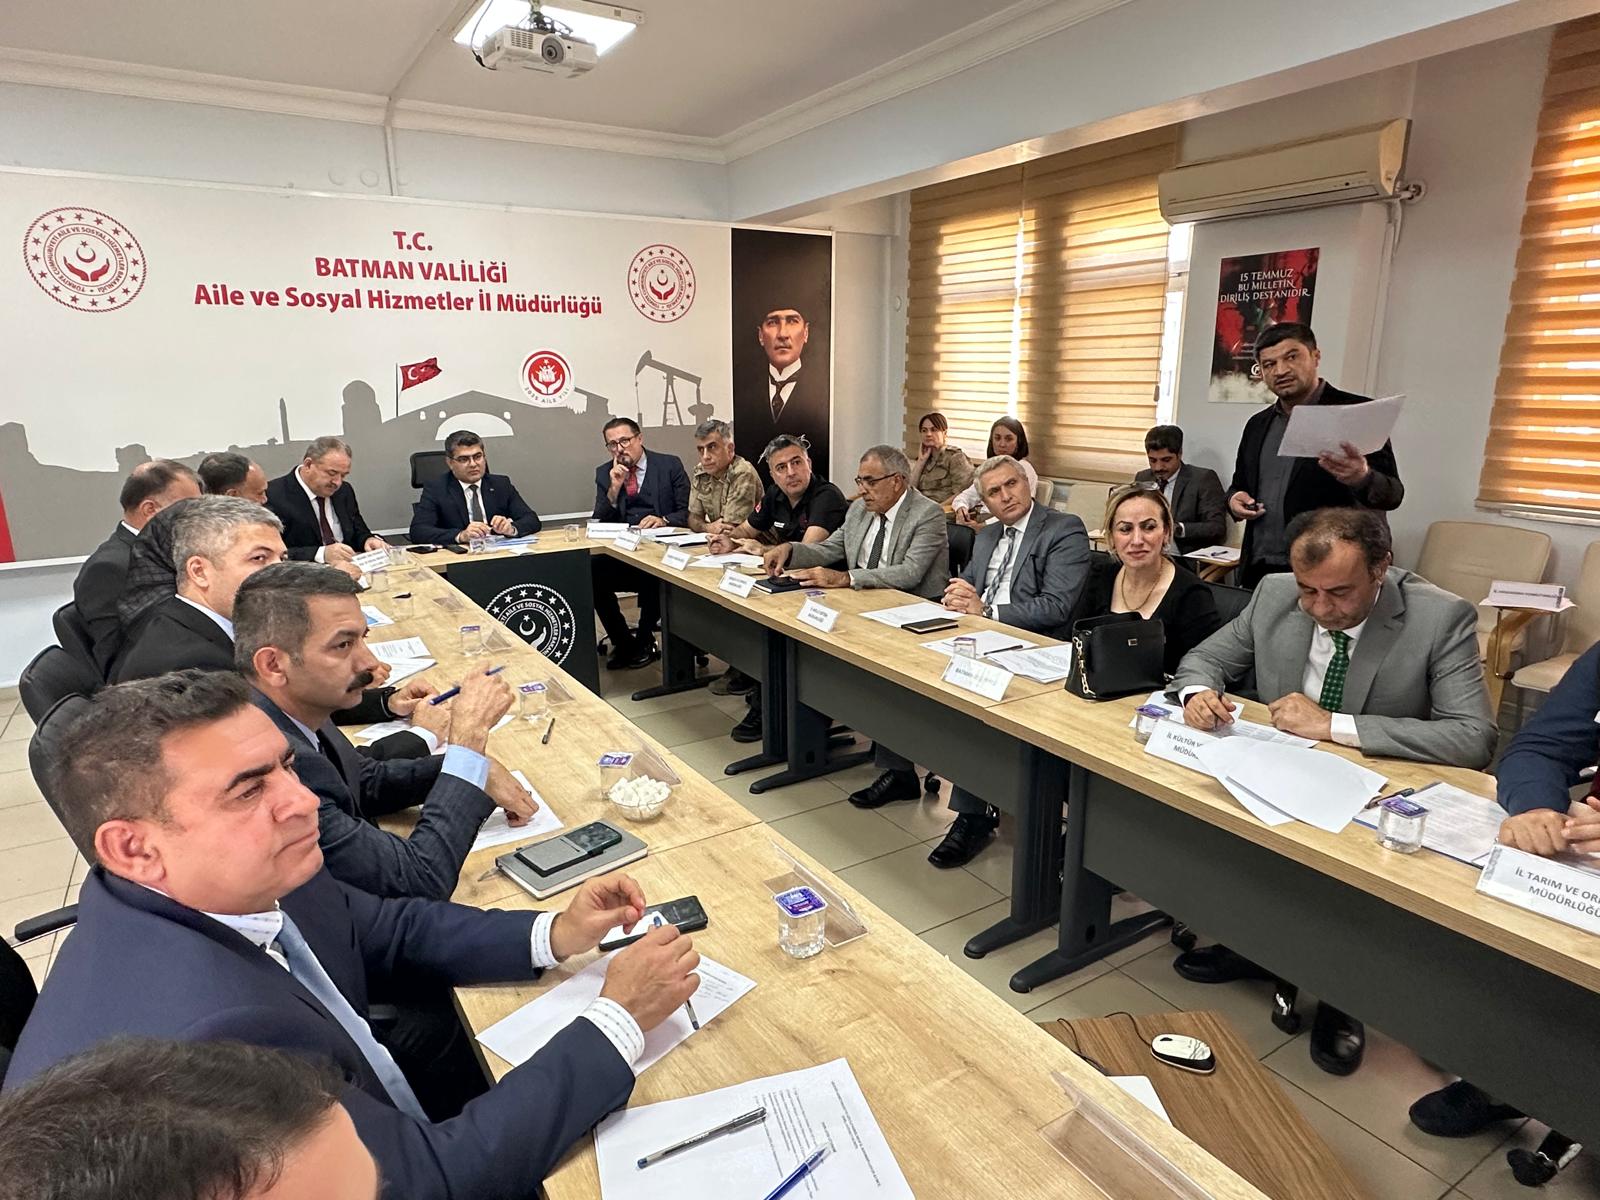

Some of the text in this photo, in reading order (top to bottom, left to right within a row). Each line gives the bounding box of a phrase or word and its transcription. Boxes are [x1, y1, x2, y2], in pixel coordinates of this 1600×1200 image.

[57, 228, 70, 237] AİLE
[81, 227, 106, 240] SOSYAL
[393, 231, 433, 251] T.C.
[315, 257, 508, 283] BATMAN VALİLİĞİ
[1240, 268, 1294, 282] 15 TEMMUZ
[1238, 278, 1297, 292] BU MİLLETİN
[194, 283, 602, 318] Aile ve Sosyal Hizmetler İl Müdürlüğü
[1220, 288, 1312, 304] DİRİLİŞ DESTANIDIR
[506, 606, 517, 616] AİLE
[525, 602, 545, 610] SOSYAL
[1173, 734, 1196, 747] KÜLTÜR
[1515, 867, 1524, 877] İL
[1527, 872, 1562, 890] TARIM
[1565, 885, 1580, 896] VE
[1528, 886, 1600, 918] MÜDÜRLÜĞÜ
